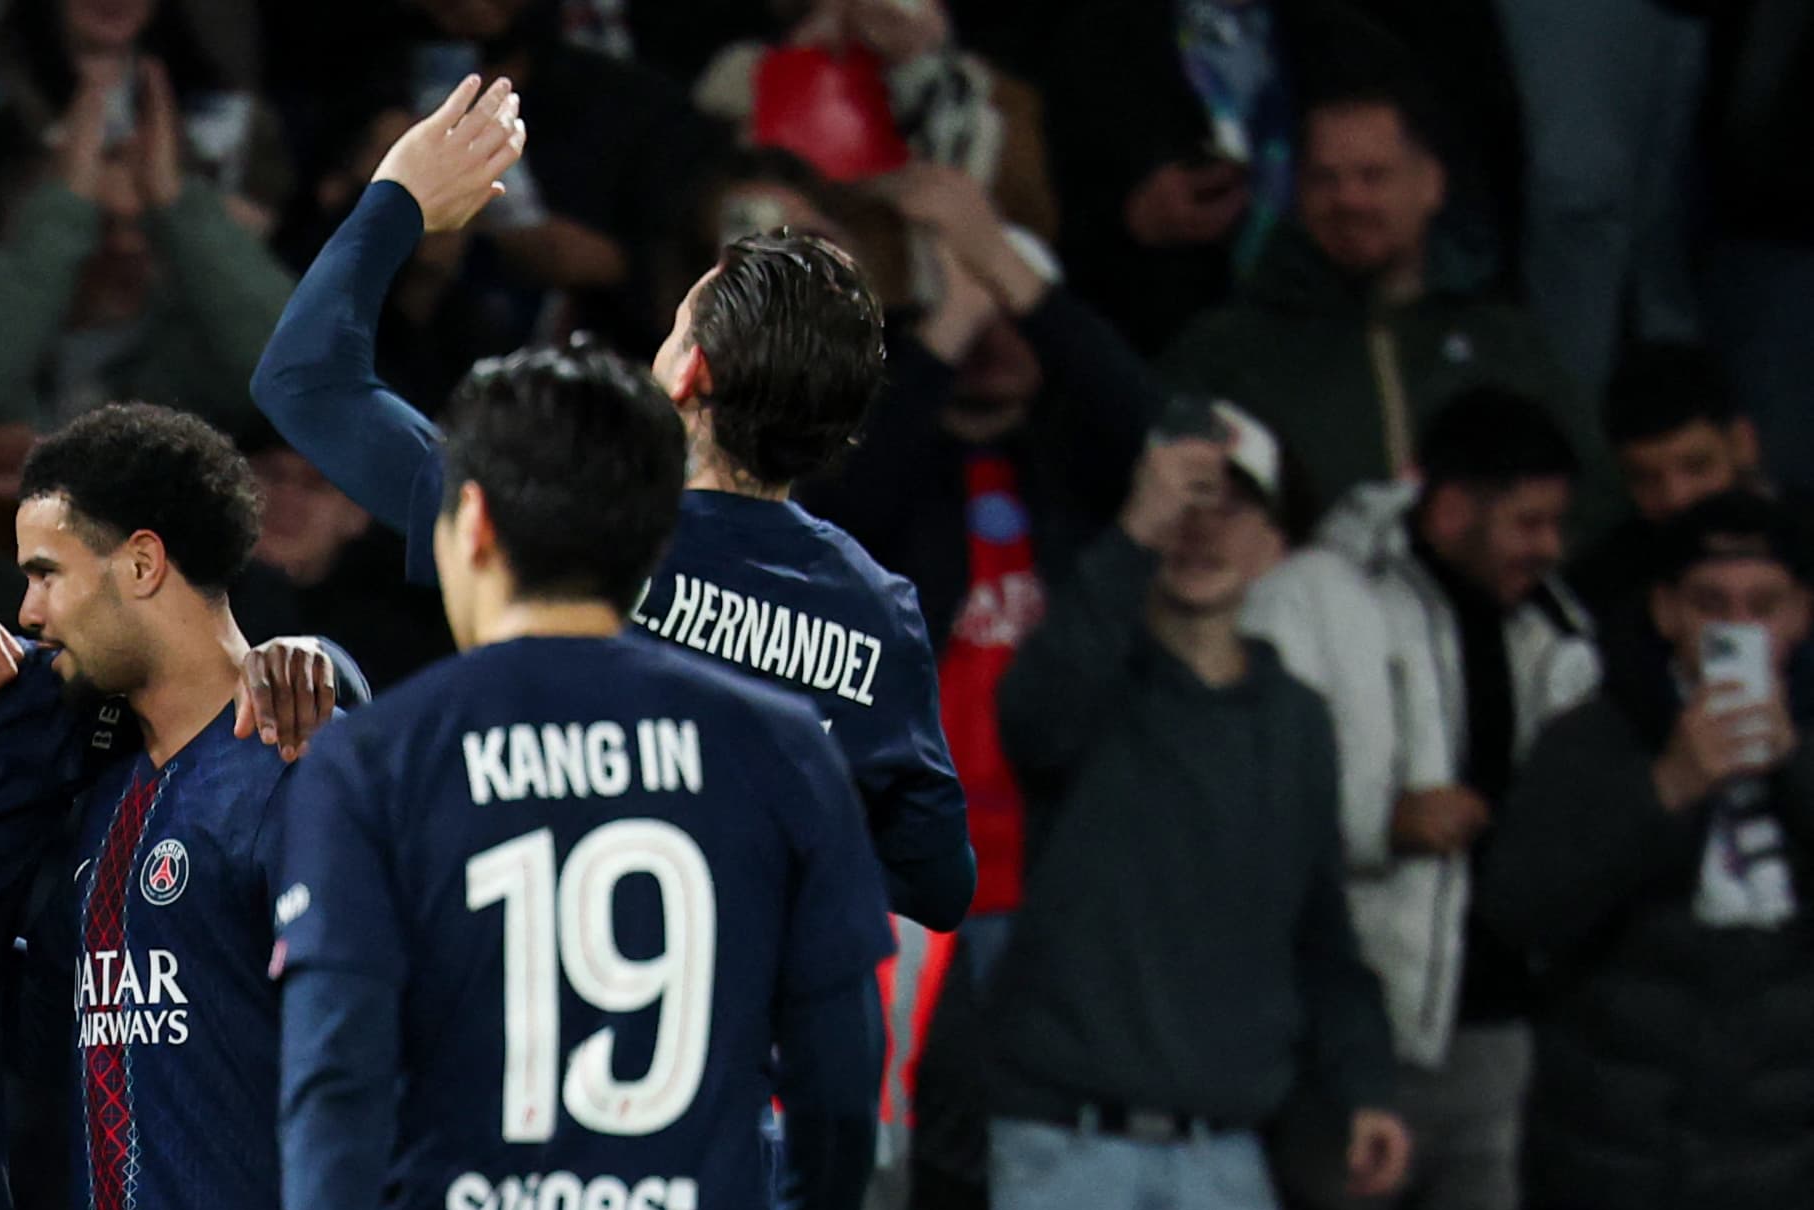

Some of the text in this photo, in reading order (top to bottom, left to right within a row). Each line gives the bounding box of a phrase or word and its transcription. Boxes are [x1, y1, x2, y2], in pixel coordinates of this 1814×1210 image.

[463, 719, 703, 805] KANG IN
[465, 817, 717, 1143] 19
[78, 1009, 189, 1048] AIRWAYS
